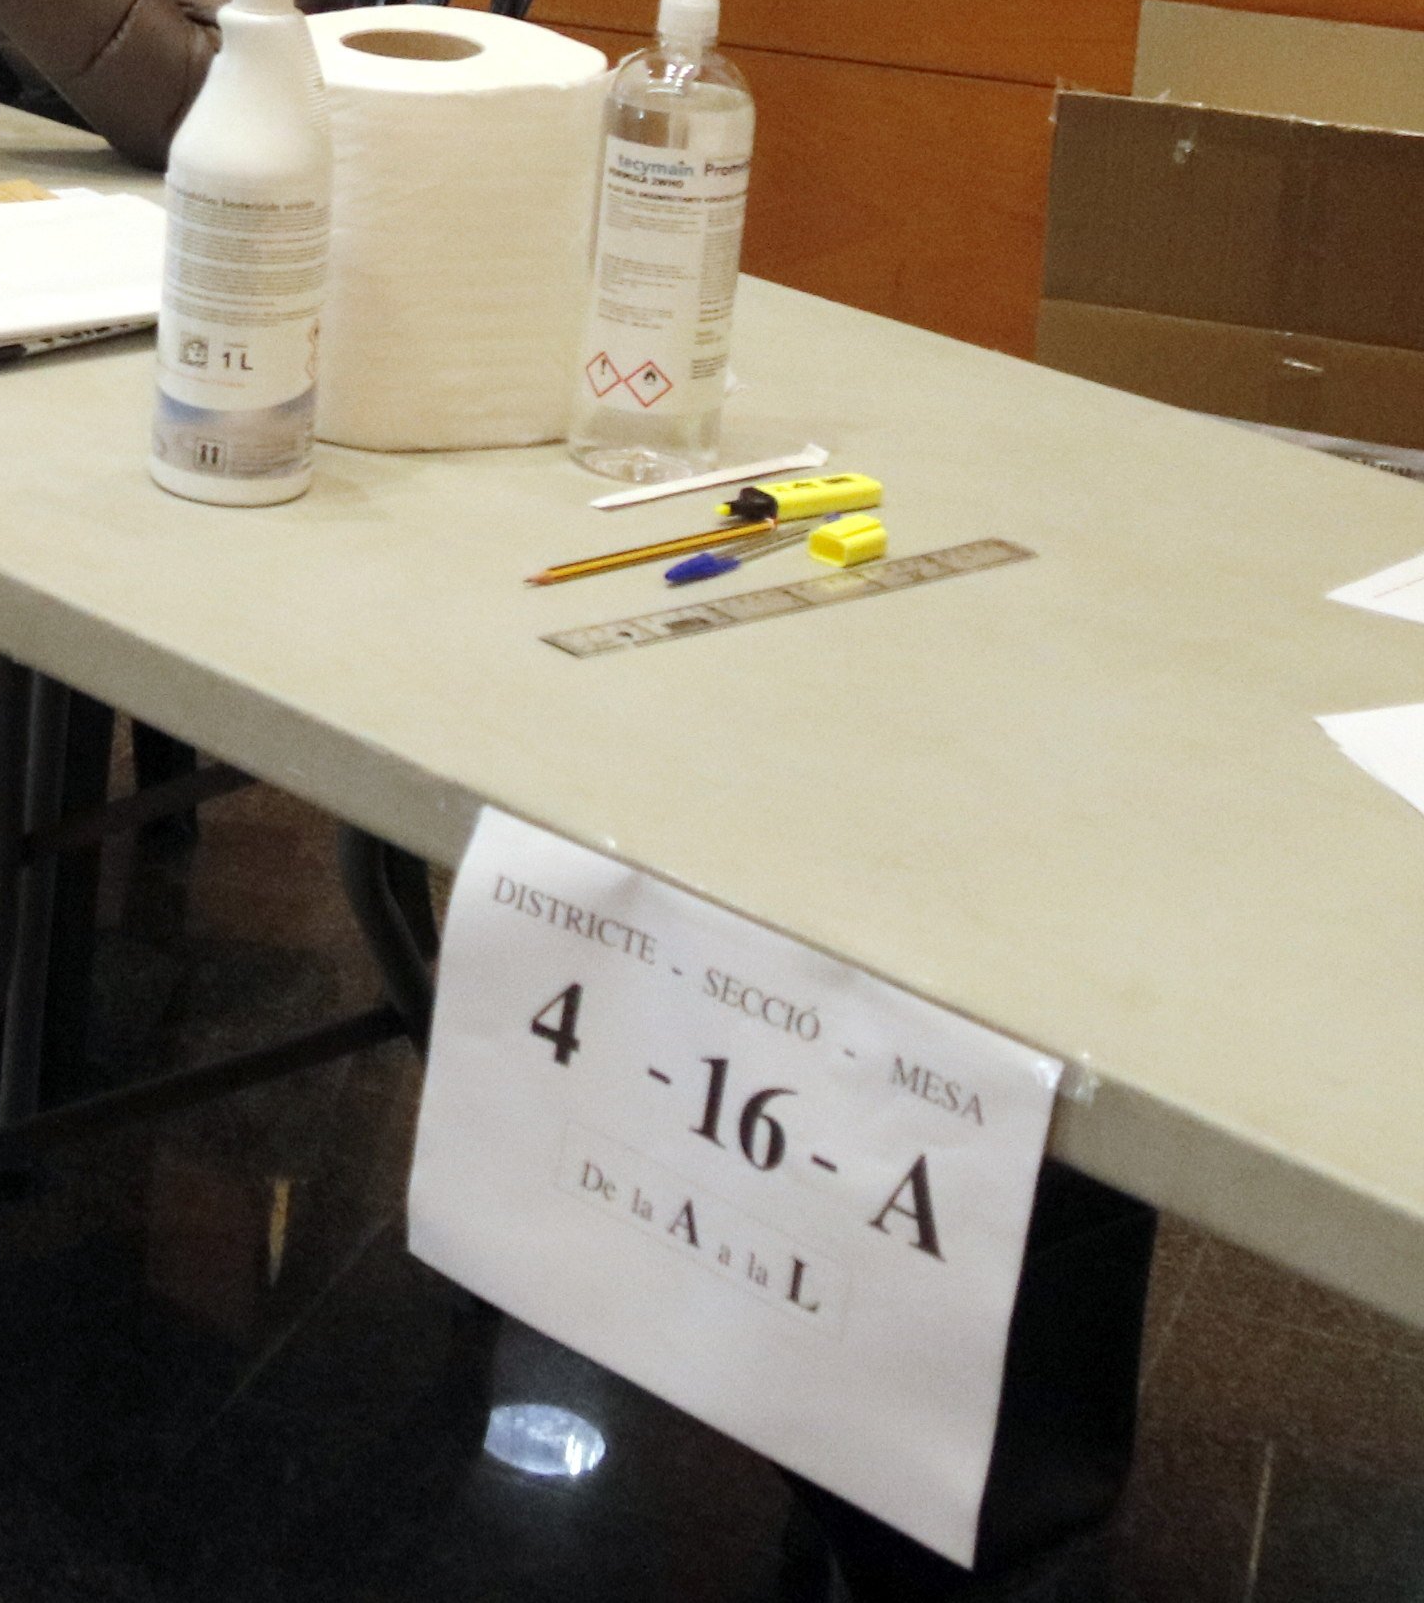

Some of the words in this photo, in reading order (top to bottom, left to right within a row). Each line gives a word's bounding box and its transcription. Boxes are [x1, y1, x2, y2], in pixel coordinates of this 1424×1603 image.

[618, 154, 694, 177] tecymain
[222, 351, 231, 369] 1
[240, 352, 254, 371] L
[493, 875, 658, 965] DISTRICTE
[703, 967, 821, 1042] SECCIÓ
[889, 1054, 984, 1127] MESA
[529, 982, 583, 1068] 4
[866, 1152, 946, 1263] A
[580, 1159, 616, 1201] De
[631, 1187, 653, 1222] la
[668, 1198, 700, 1248] A
[717, 1243, 732, 1266] a
[747, 1250, 768, 1288] la
[786, 1254, 821, 1313] L
